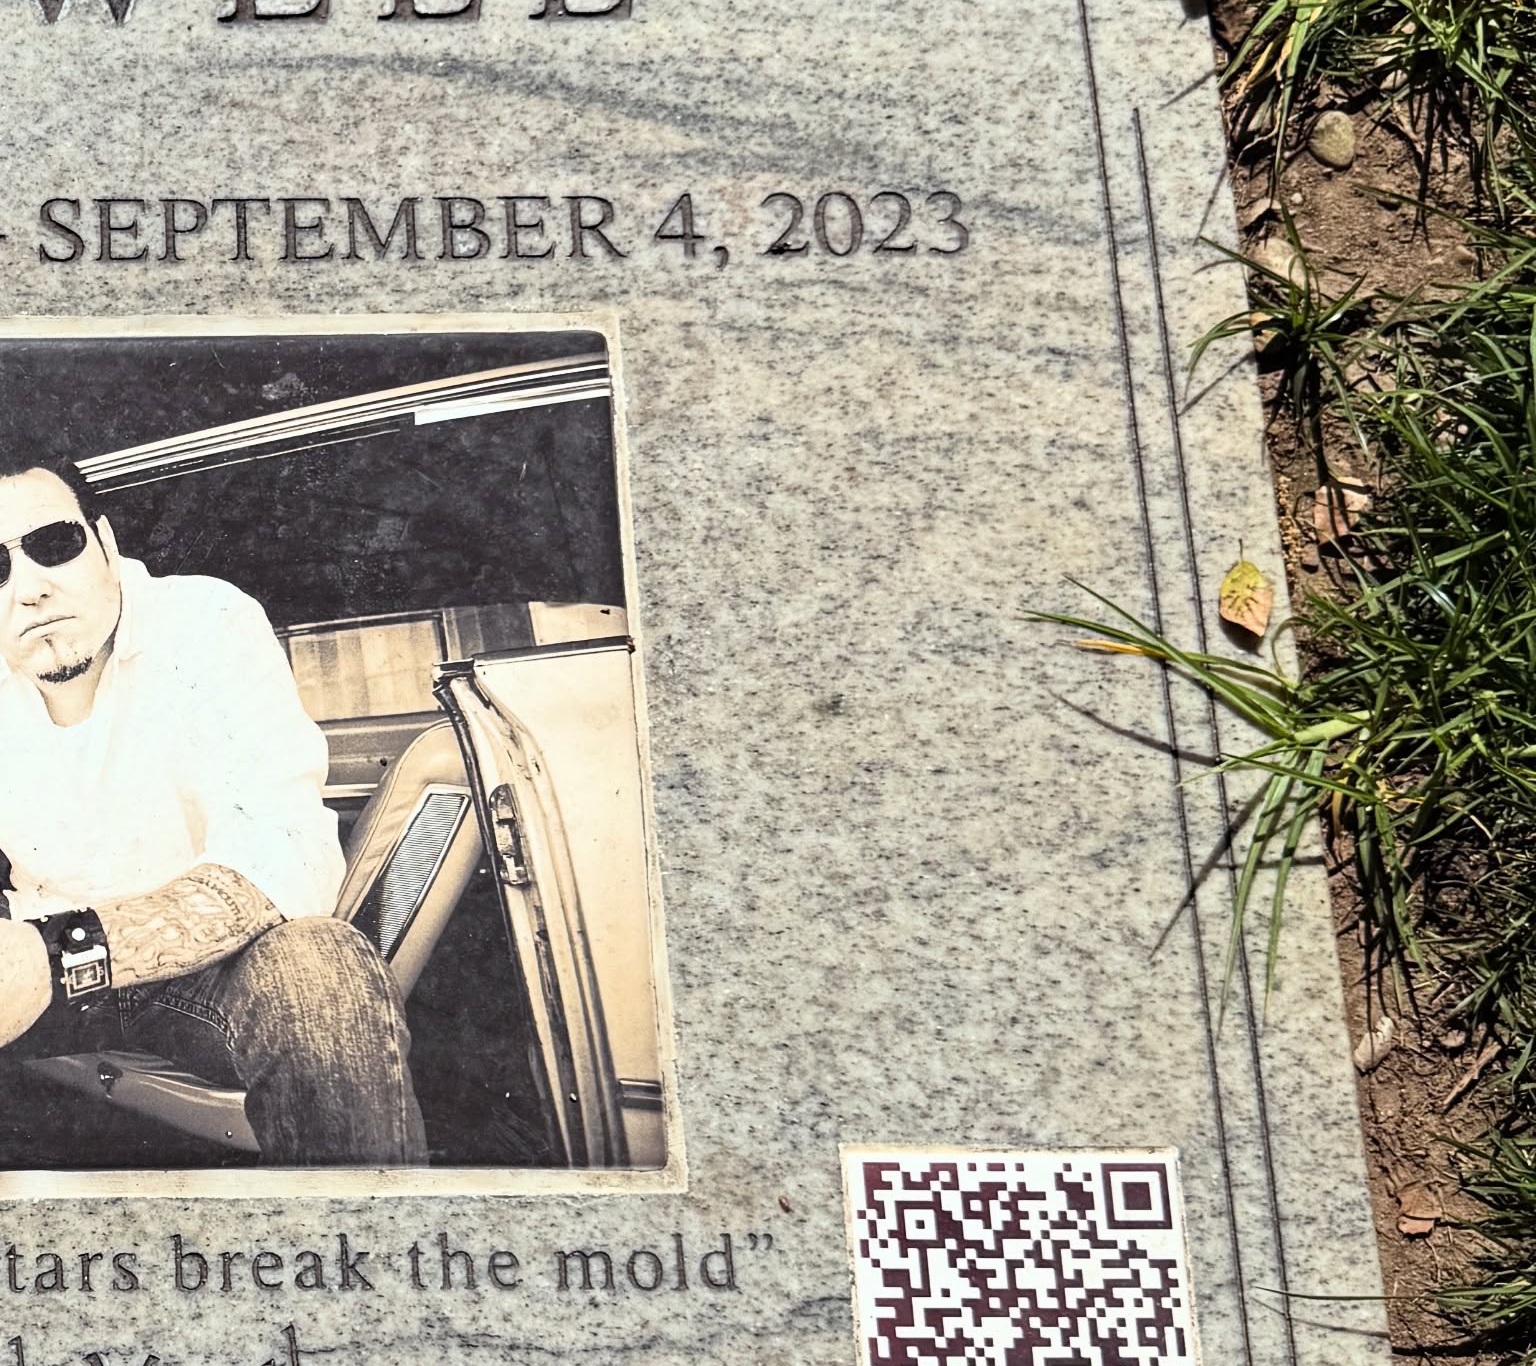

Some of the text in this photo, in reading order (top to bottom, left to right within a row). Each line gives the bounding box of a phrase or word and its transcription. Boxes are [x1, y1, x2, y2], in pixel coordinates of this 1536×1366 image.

[37, 194, 628, 264] SEPTEMBER
[654, 192, 730, 270] 4,
[760, 191, 971, 258] 2023
[169, 1233, 374, 1293] break
[408, 1233, 521, 1292] the
[555, 1232, 773, 1292] mold”
